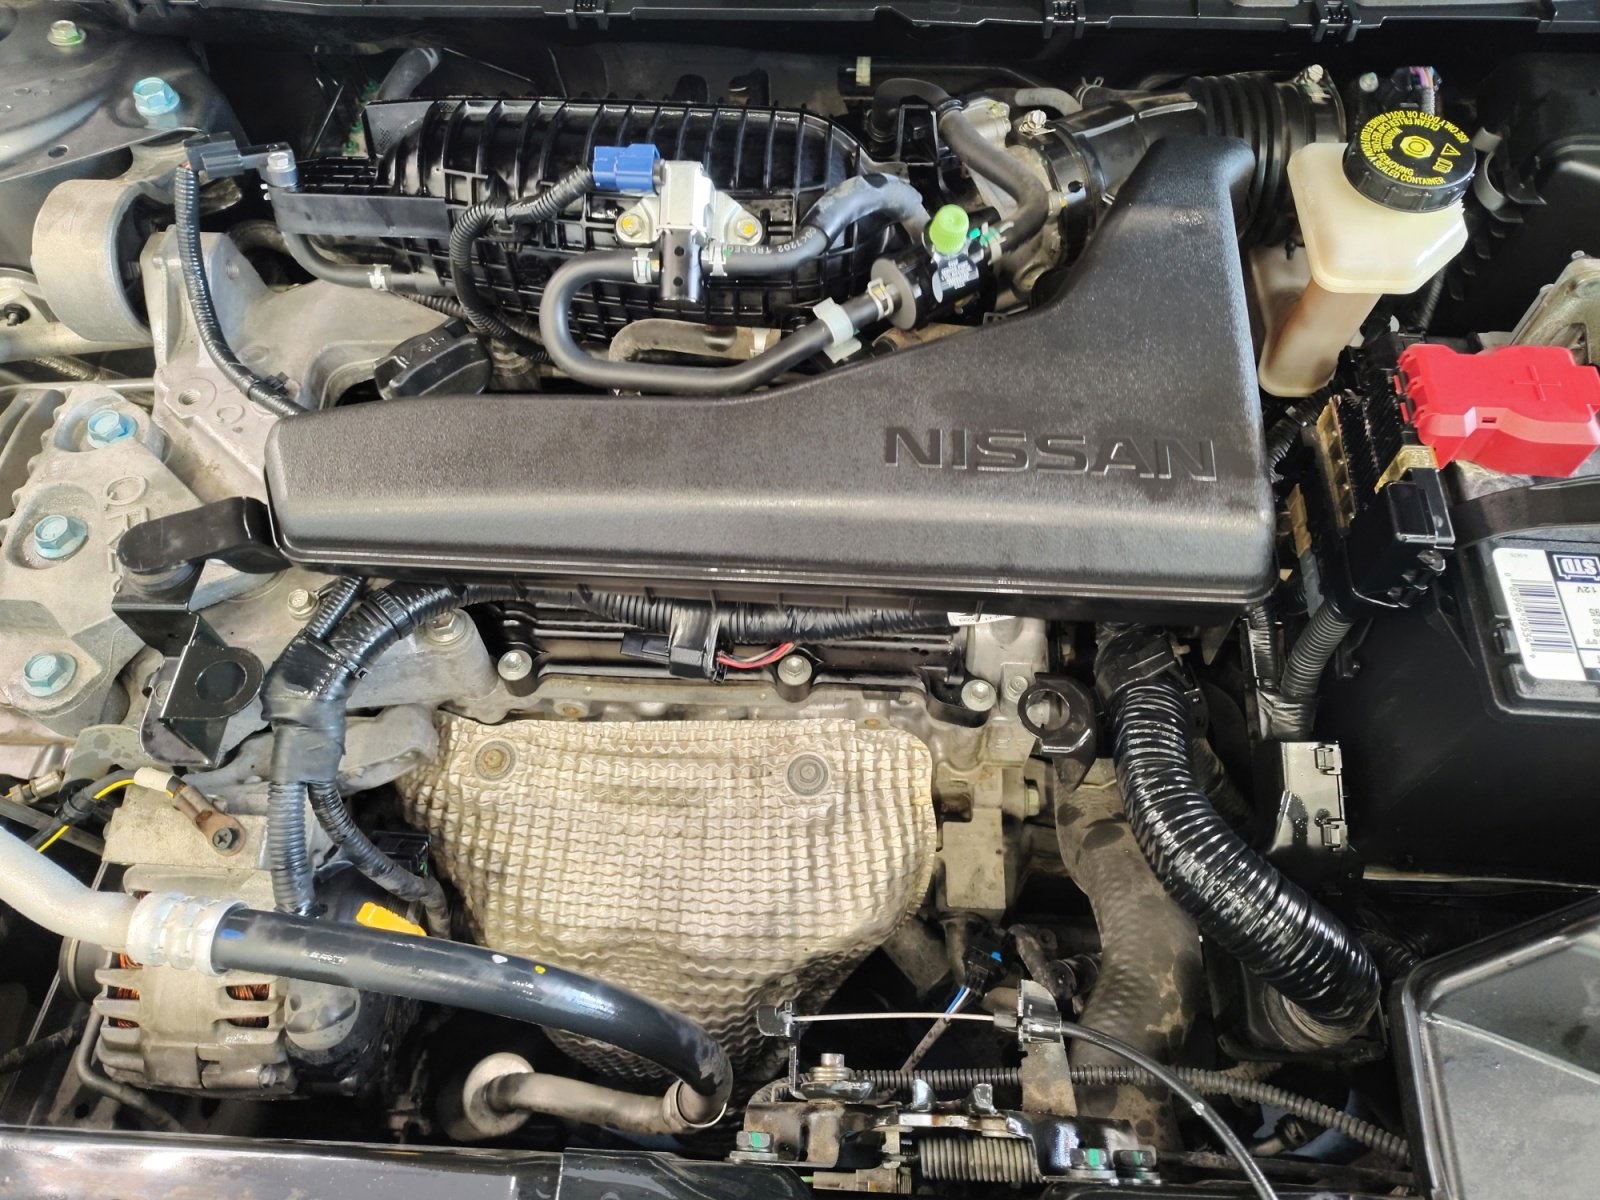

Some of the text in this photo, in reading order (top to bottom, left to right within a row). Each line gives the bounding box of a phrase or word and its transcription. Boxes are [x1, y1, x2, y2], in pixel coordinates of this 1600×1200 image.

[1385, 111, 1405, 119] DOT4
[1420, 112, 1440, 123] DOT3
[1387, 117, 1413, 127] FILLER
[1415, 119, 1440, 131] CLEAN
[1439, 120, 1459, 133] ONLY
[1382, 127, 1403, 150] WARNING
[1454, 131, 1470, 143] USE
[1373, 160, 1400, 178] SEALED
[1377, 153, 1414, 175] REMOVING
[1401, 174, 1446, 185] CONTAINER
[885, 428, 1217, 481] NISSAN
[1560, 558, 1597, 576] STD
[1576, 586, 1597, 594] 12V
